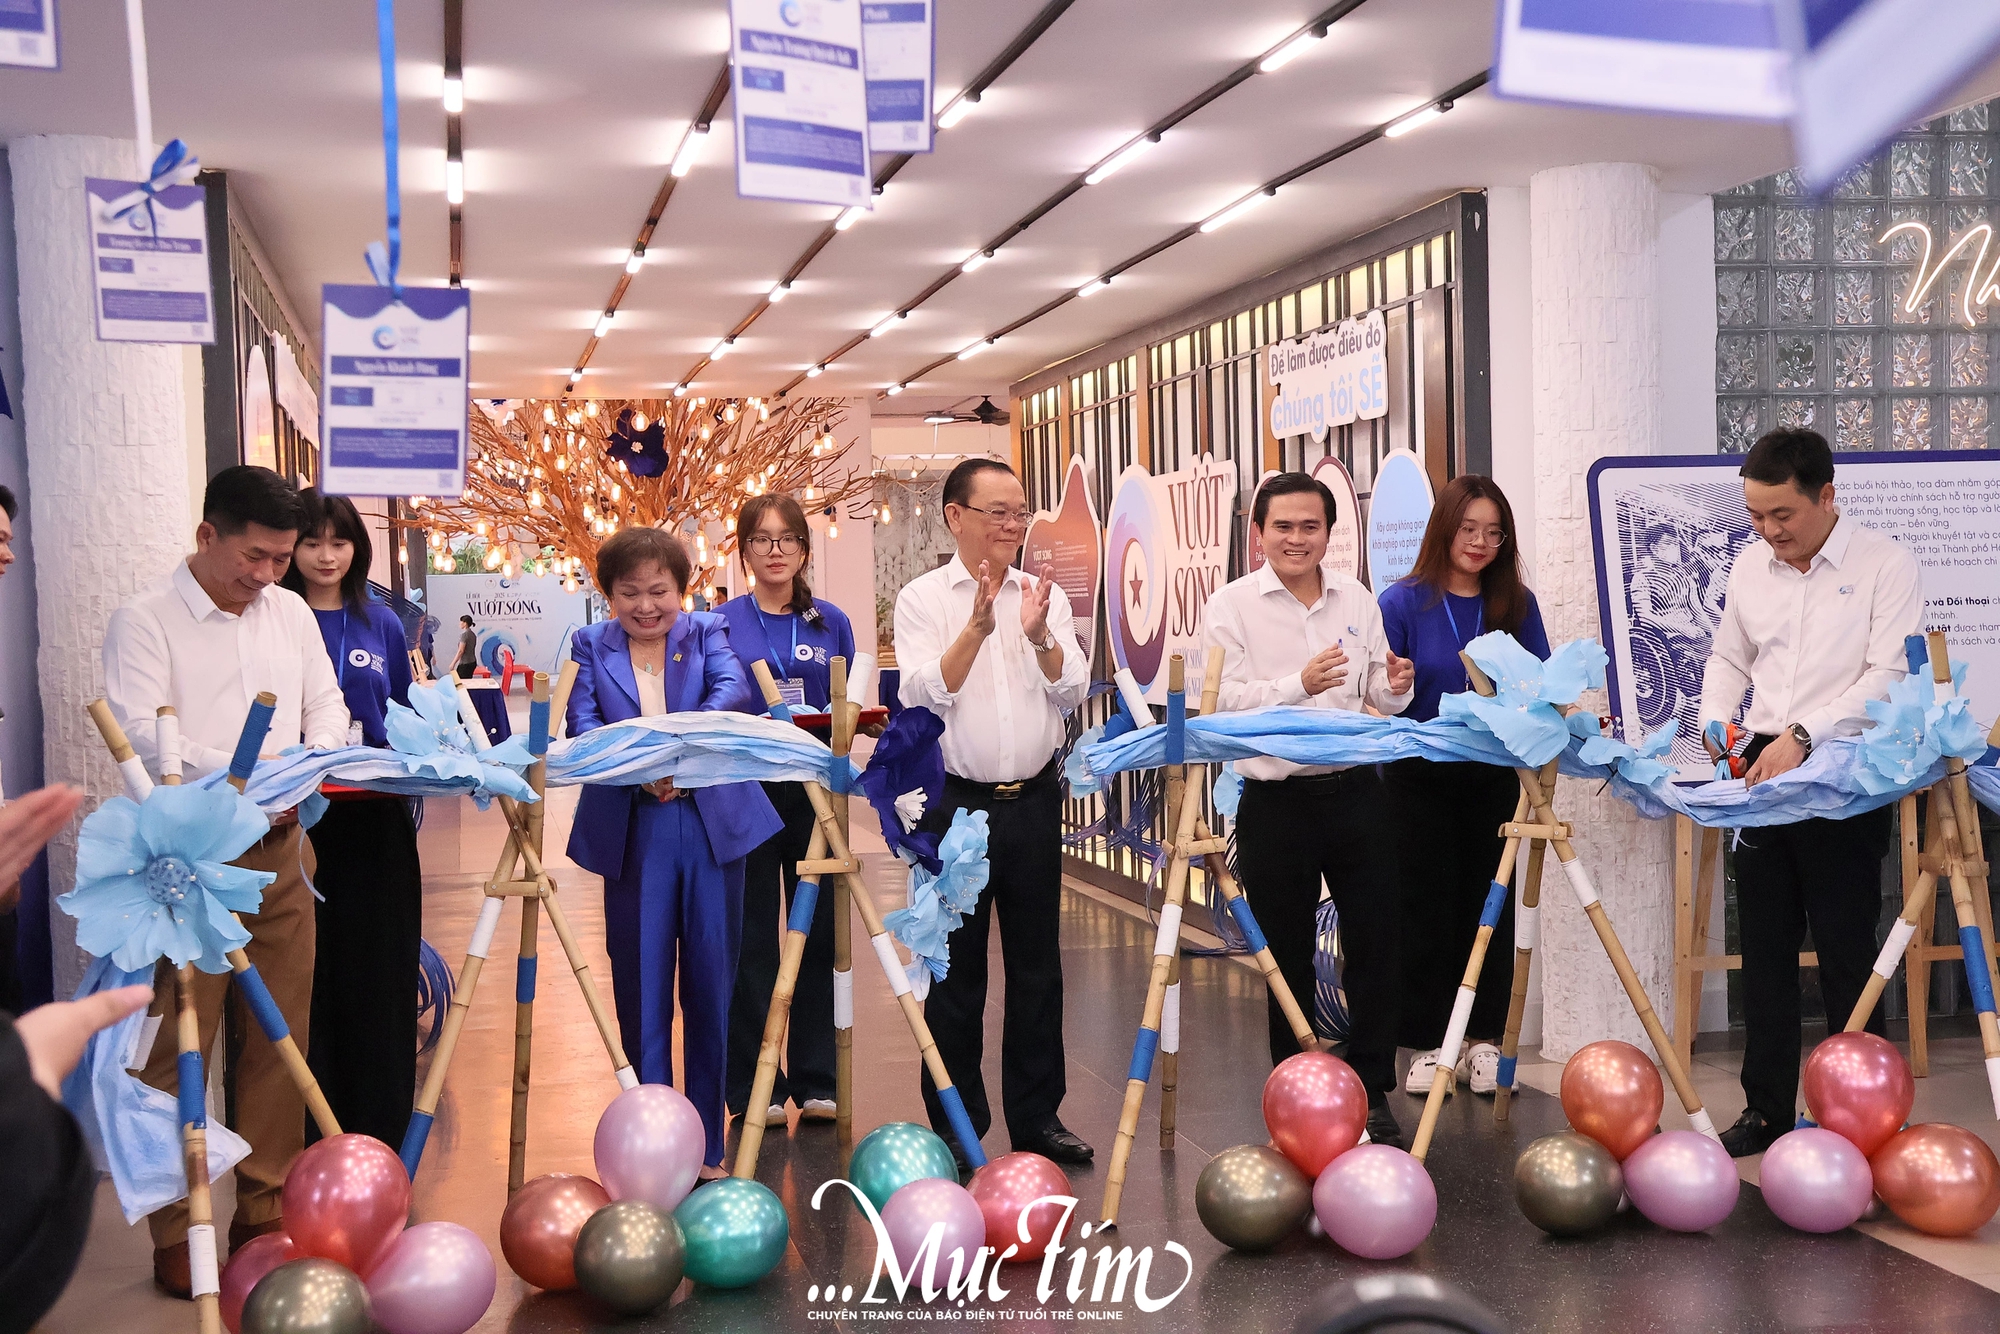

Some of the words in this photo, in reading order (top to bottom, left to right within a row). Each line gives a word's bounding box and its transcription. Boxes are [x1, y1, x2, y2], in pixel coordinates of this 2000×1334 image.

[1271, 350, 1284, 377] Để
[1287, 349, 1306, 372] làm
[1309, 341, 1335, 369] được
[1338, 327, 1362, 357] điều
[1366, 321, 1381, 349] đó
[1273, 387, 1324, 434] chúng
[1329, 372, 1353, 418] tôi
[1360, 352, 1382, 411] SẼ
[1834, 481, 1851, 490] các
[1854, 480, 1873, 490] buổi
[1876, 480, 1889, 491] hội
[1891, 480, 1914, 490] thảo,
[1917, 481, 1932, 491] tọa
[1935, 479, 1955, 488] đàm
[1851, 494, 1874, 505] pháp
[1877, 493, 1884, 504] lý
[1887, 494, 1898, 502] và
[1900, 492, 1924, 502] chính
[1926, 492, 1947, 501] sách
[1949, 491, 1960, 500] hỗ
[1963, 492, 1976, 503] trợ
[1978, 491, 2000, 502] ngườ
[1168, 465, 1224, 560] VƯỢT
[1847, 507, 1865, 516] đến
[1867, 507, 1883, 516] môi
[1886, 506, 1915, 518] trường
[1917, 505, 1941, 517] sống,
[1943, 505, 1960, 516] học
[1963, 505, 1978, 515] tập
[1981, 504, 1992, 513] và
[1881, 519, 1898, 531] cận
[1907, 518, 1926, 528] bền
[1928, 518, 1951, 530] vững.
[1903, 532, 1930, 543] Người
[1933, 531, 1961, 541] khuyết
[1964, 530, 1976, 541] tật
[1979, 530, 1990, 539] và
[1914, 545, 1926, 556] tật
[1929, 545, 1940, 556] tại
[1942, 543, 1969, 553] Thành
[1972, 543, 1989, 554] phố
[1921, 557, 1939, 566] trên
[1941, 557, 1951, 566] kế
[1954, 557, 1982, 568] hoạch
[1985, 556, 1997, 565] chi
[467, 599, 505, 617] VƯỢT
[504, 597, 541, 615] SÓNG
[1932, 598, 1944, 606] và
[1946, 597, 1963, 606] Đối
[1965, 596, 1990, 607] thoại
[1931, 610, 1958, 620] thành.
[1954, 624, 1976, 634] được
[1961, 636, 1982, 645] sách
[1985, 635, 1996, 644] và
